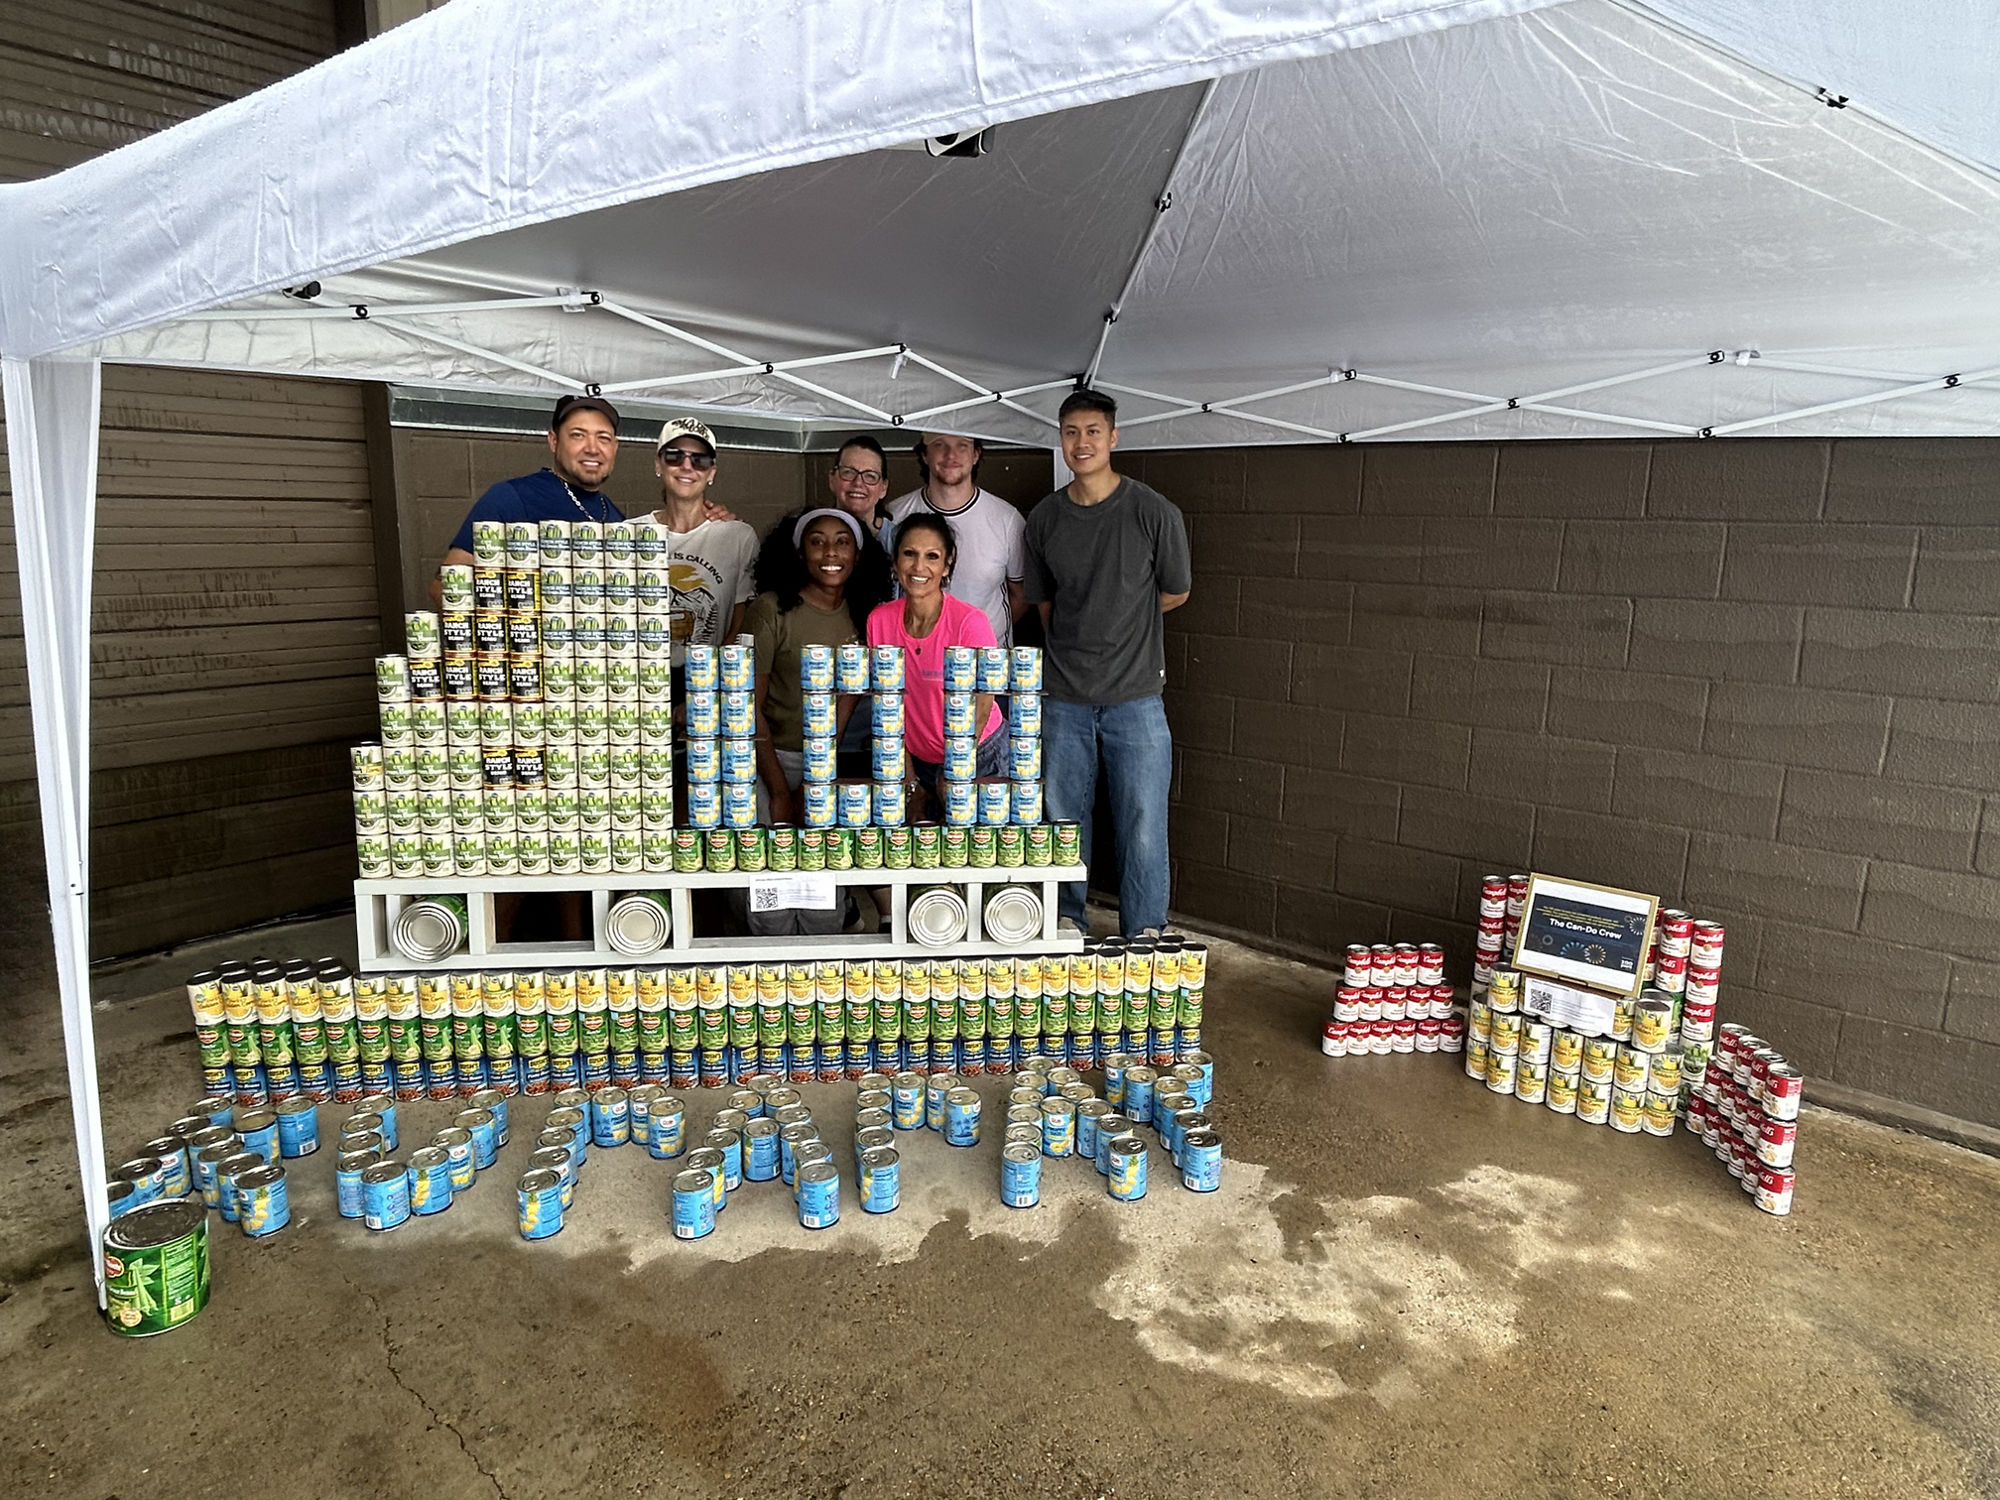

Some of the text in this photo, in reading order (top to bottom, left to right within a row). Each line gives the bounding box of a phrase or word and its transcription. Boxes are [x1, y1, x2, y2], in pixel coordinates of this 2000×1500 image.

[674, 552, 724, 585] IS CALLING
[1549, 918, 1623, 940] The Can-Do Crew
